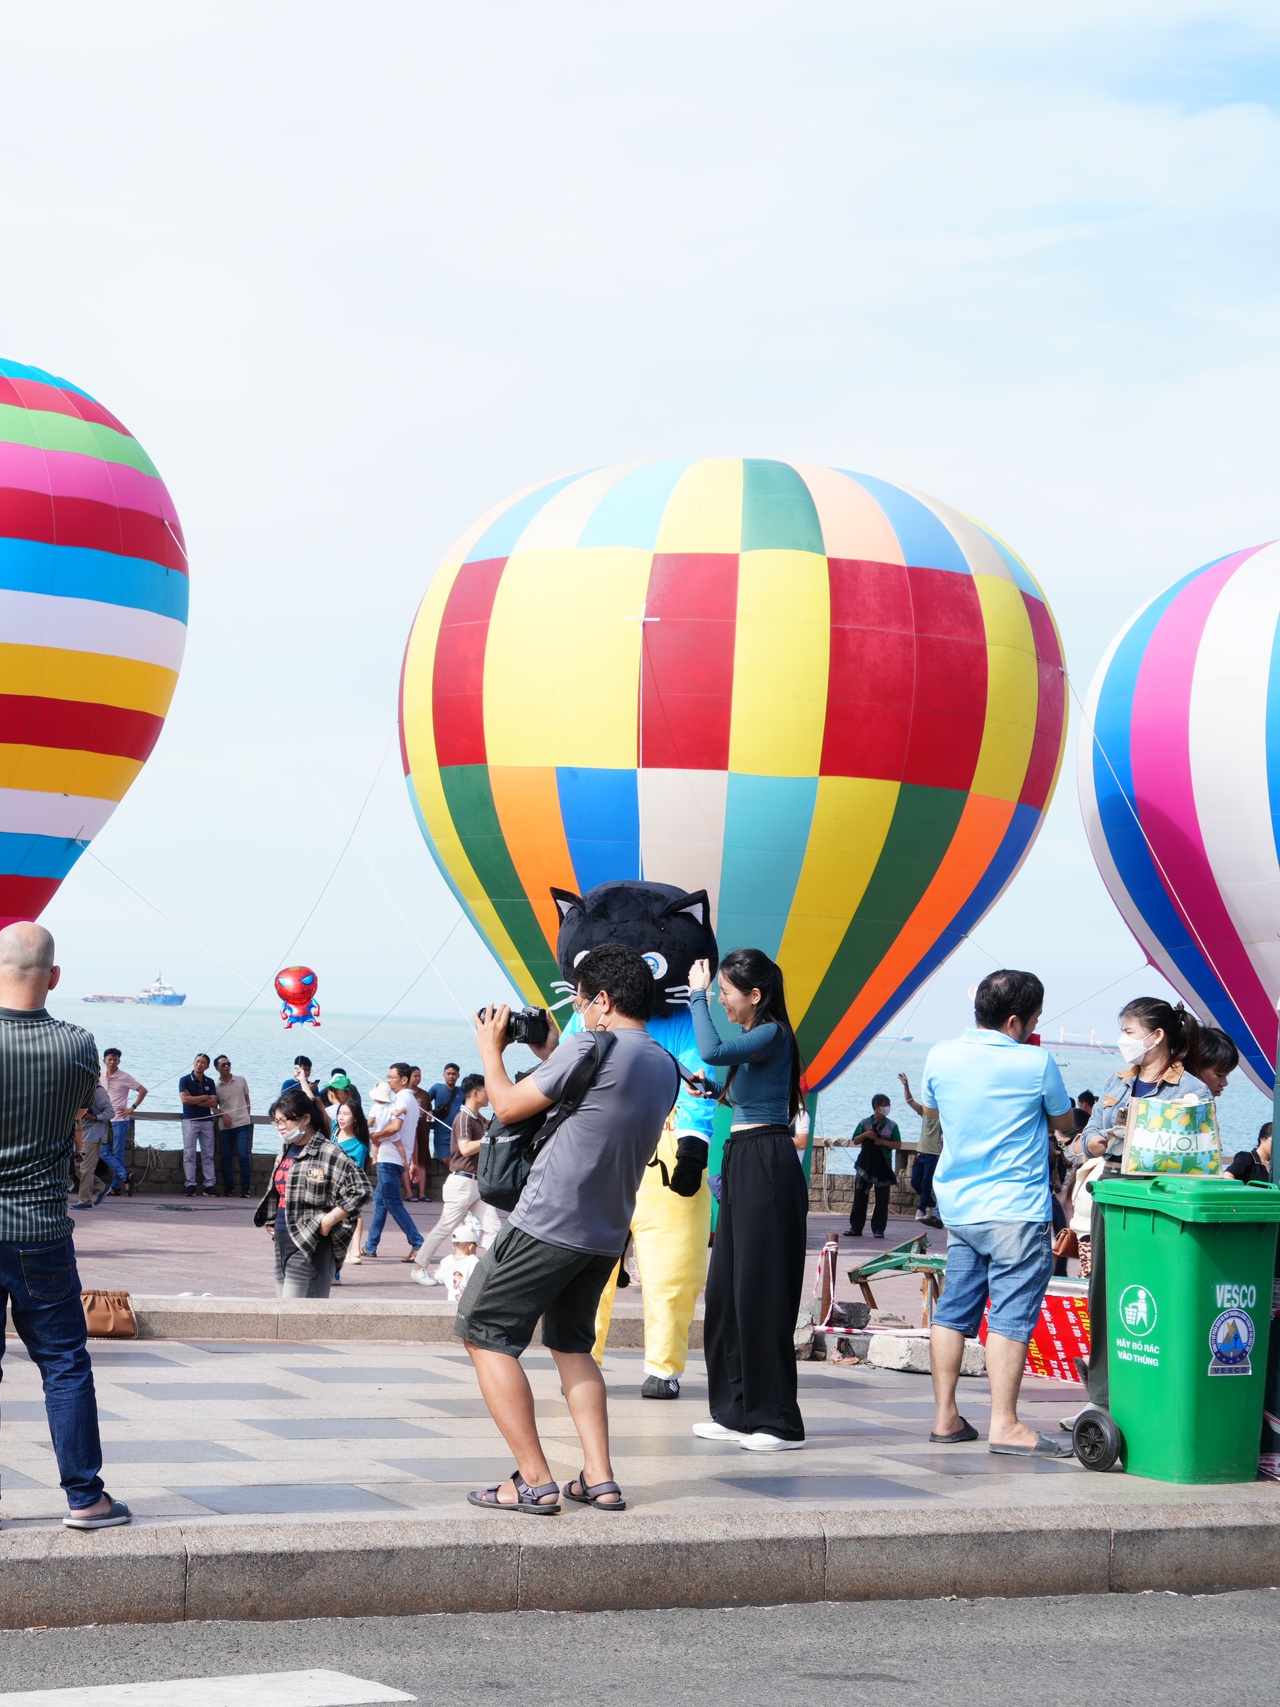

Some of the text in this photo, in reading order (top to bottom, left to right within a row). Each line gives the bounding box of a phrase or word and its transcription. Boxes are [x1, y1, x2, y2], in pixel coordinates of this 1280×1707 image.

[1155, 1134, 1199, 1151] M.O.I
[1216, 1284, 1256, 1308] VESCO
[1046, 1322, 1057, 1334] 22h
[1116, 1338, 1160, 1354] HÃY BỎ RÁC
[1117, 1351, 1159, 1366] VÀO THÙNG
[1213, 1366, 1247, 1374] VESCO
